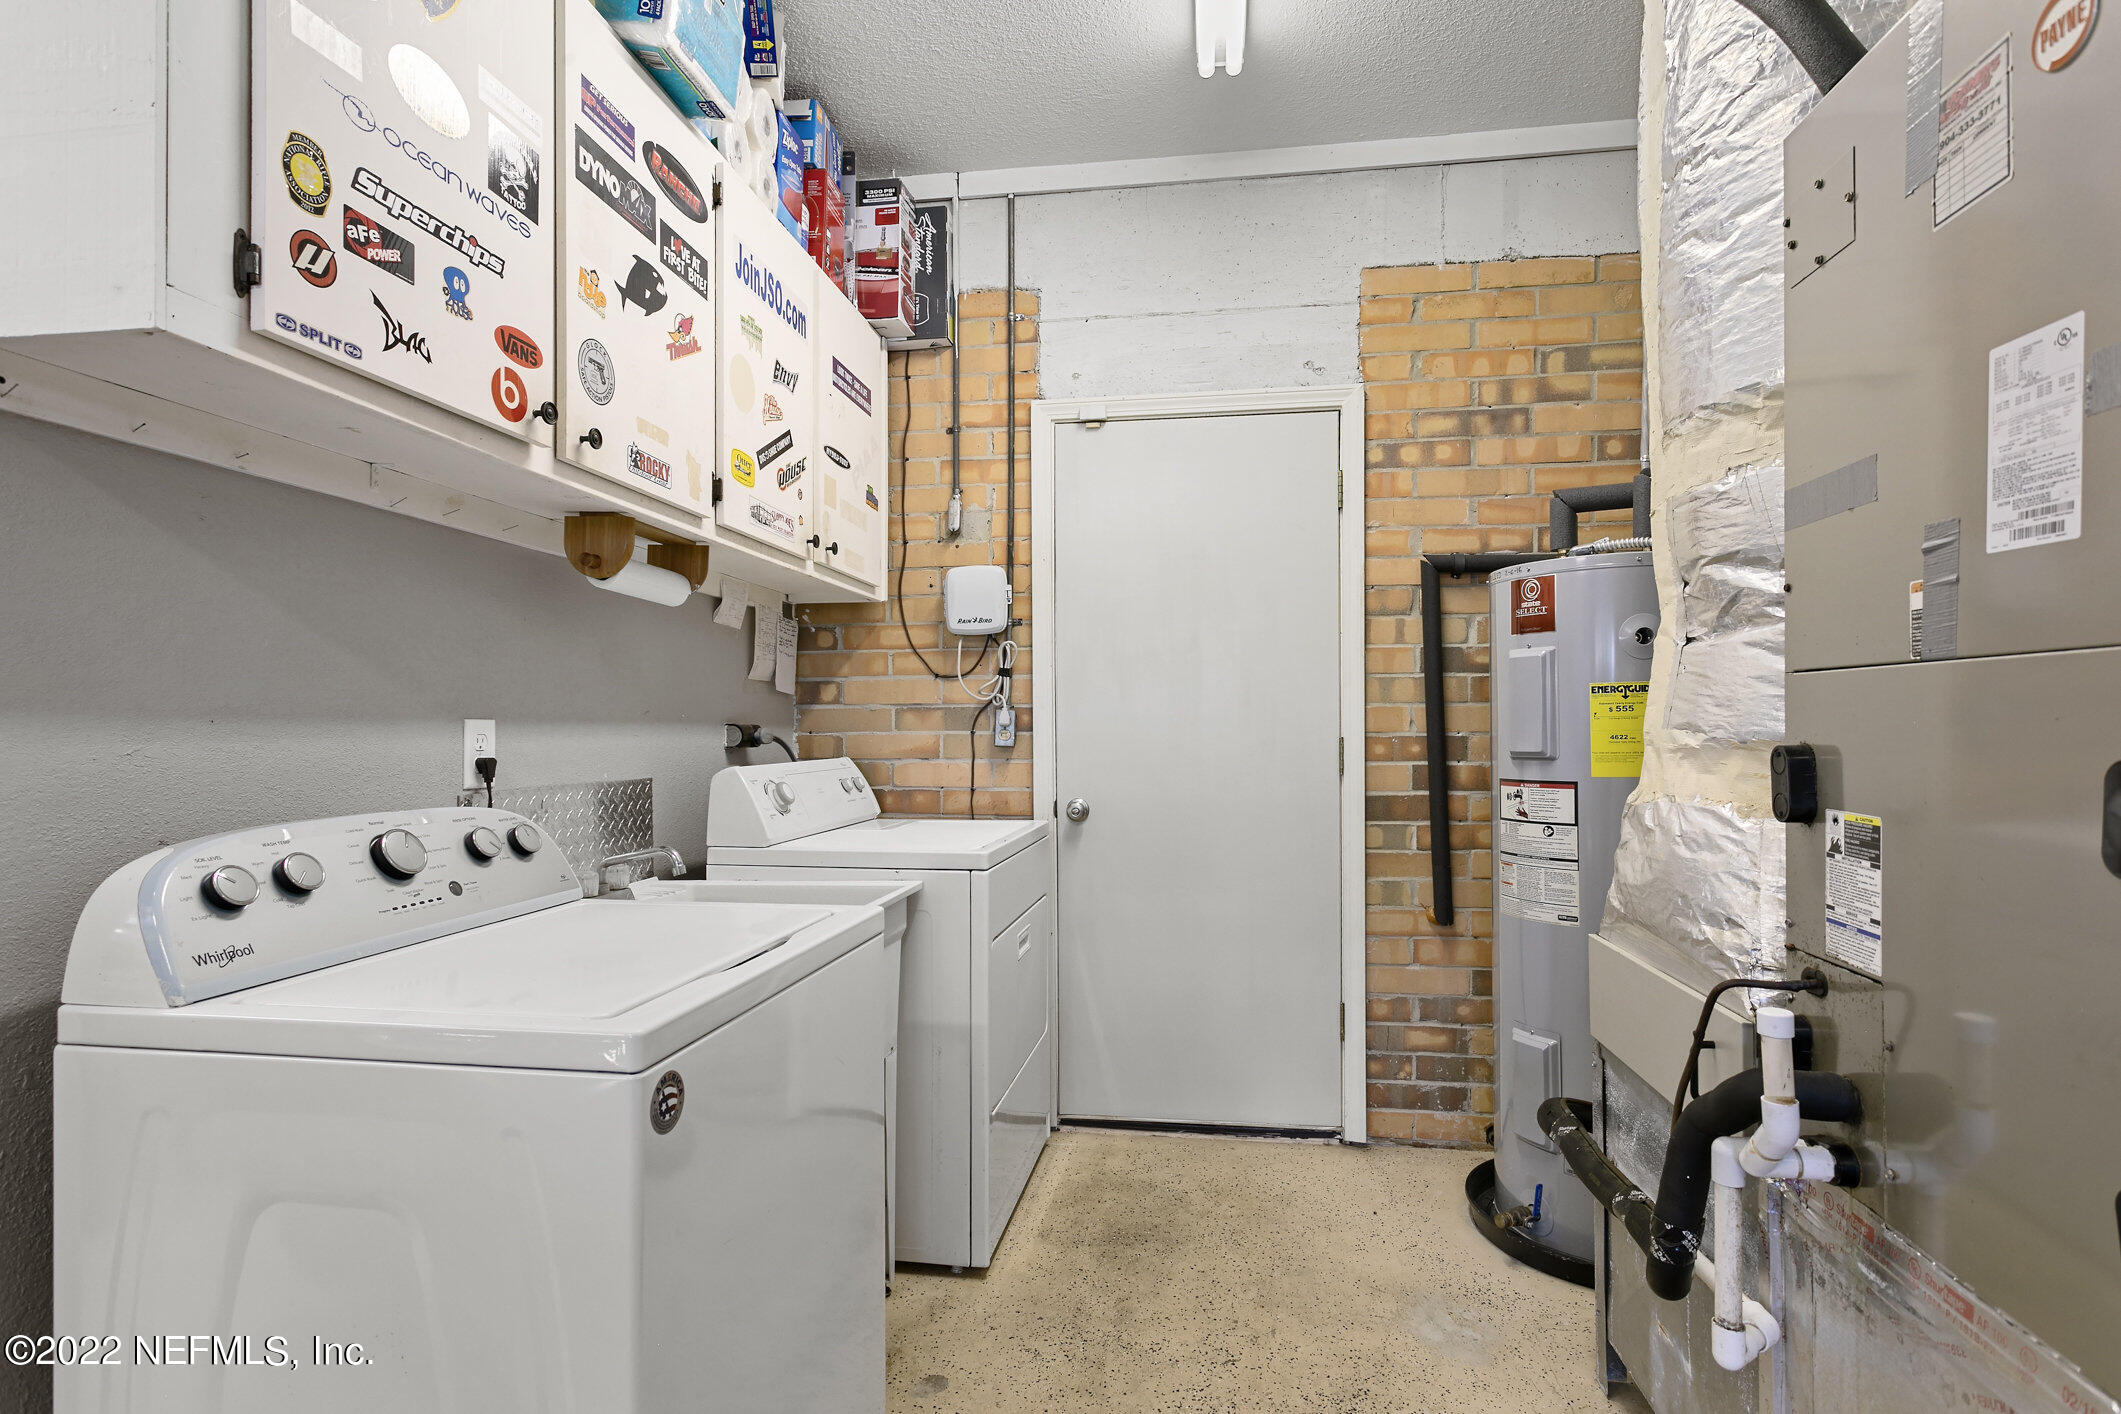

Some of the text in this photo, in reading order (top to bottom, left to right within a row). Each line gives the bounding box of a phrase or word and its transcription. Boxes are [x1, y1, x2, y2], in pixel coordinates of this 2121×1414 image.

[2039, 3, 2086, 54] PAYNE
[291, 133, 323, 157] MEMBER
[285, 169, 329, 205] ASSOCIATION
[651, 149, 701, 215] RANCHO
[864, 186, 896, 196] 3300 PSI
[300, 200, 315, 214] 2012
[500, 186, 527, 212] TATTOO
[346, 222, 381, 245] aFe
[351, 166, 504, 279] Superchips
[367, 247, 402, 263] POWER
[924, 212, 938, 276] American
[663, 245, 708, 295] FIRST BITE!
[691, 255, 701, 273] AT
[735, 243, 807, 340] JoinJSO.com
[299, 323, 342, 352] SPLIT
[499, 328, 539, 368] VANS
[773, 359, 799, 394] envy
[639, 452, 670, 483] ROCKY
[1515, 606, 1548, 616] SELECT
[191, 942, 255, 970] Whirlpool
